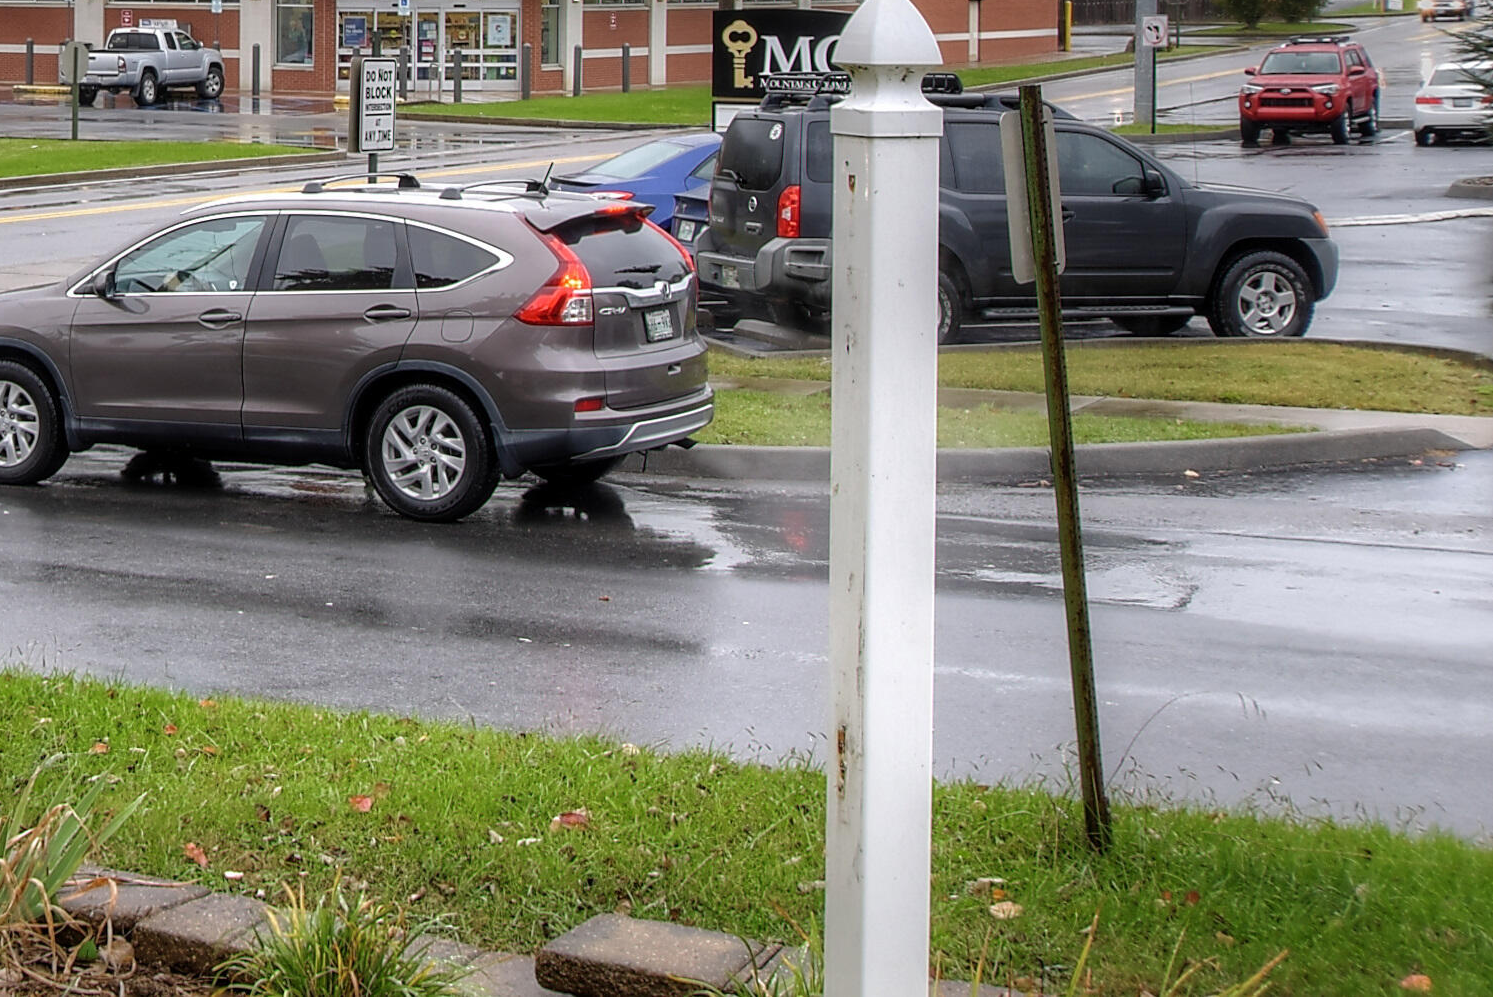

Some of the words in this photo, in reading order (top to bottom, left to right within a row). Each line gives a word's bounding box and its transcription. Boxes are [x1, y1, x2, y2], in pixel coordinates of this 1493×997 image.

[366, 70, 376, 82] DO
[378, 69, 392, 82] NOT
[365, 87, 392, 100] BLOCK
[365, 130, 376, 141] ANY
[378, 130, 391, 142] TIME
